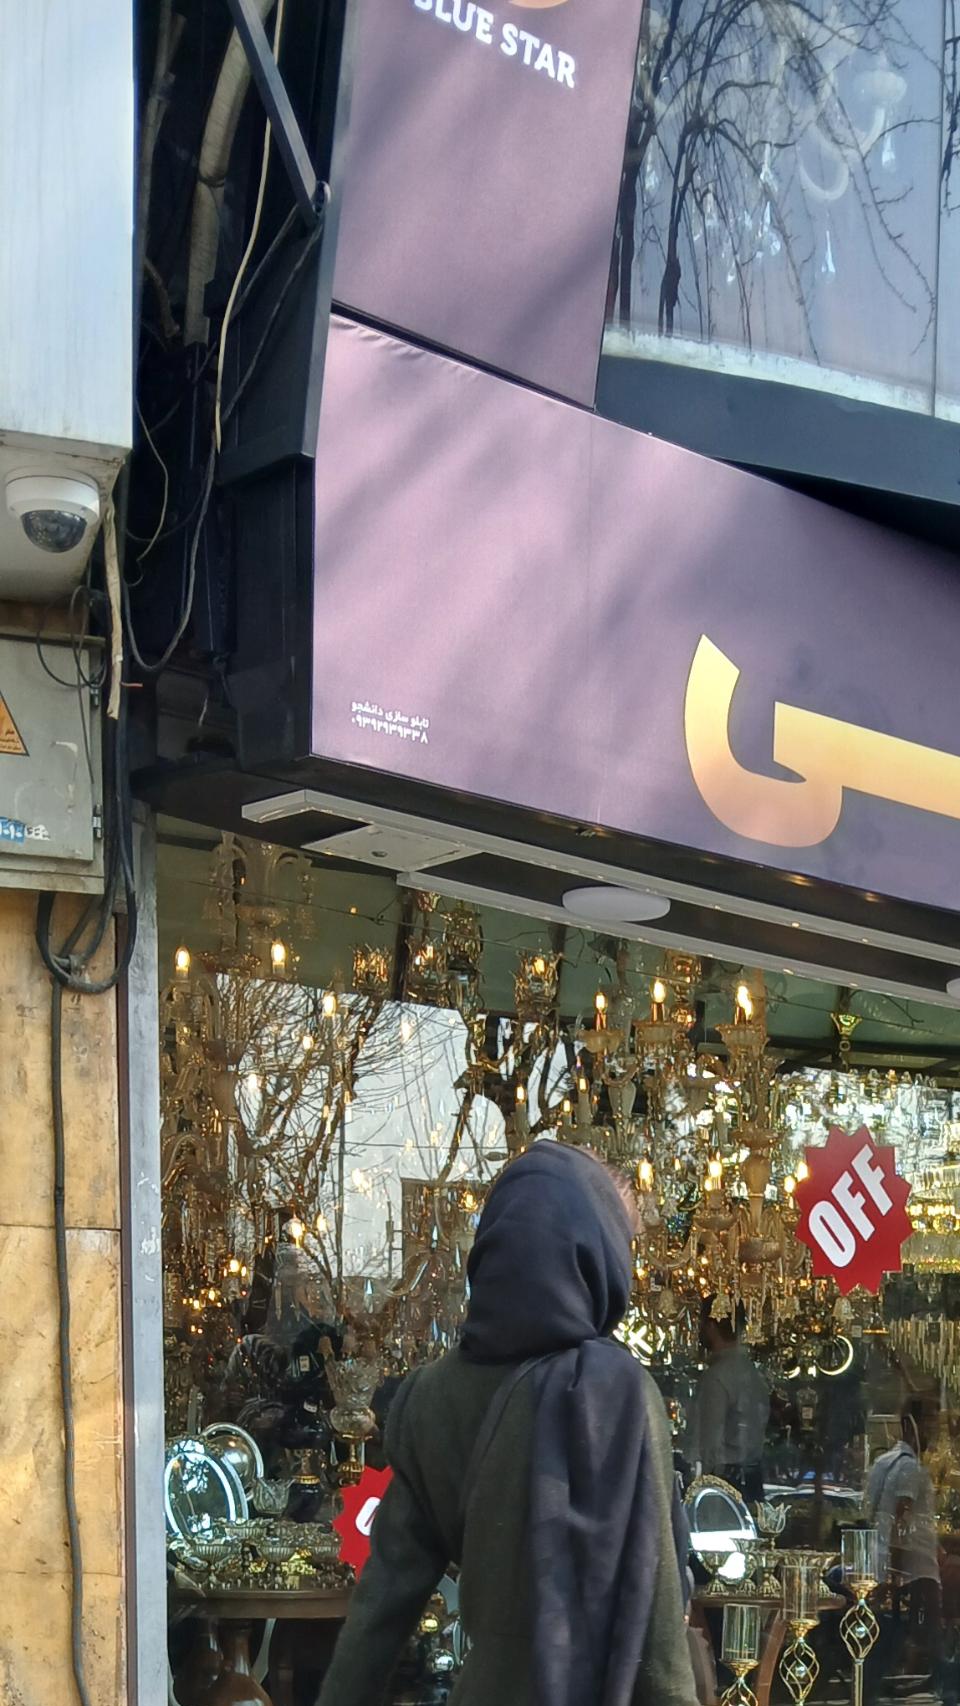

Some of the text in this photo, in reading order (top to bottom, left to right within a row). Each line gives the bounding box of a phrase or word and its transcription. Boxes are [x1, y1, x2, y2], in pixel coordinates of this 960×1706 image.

[500, 22, 575, 88] STAR
[351, 701, 430, 730] تابلو سازی دانشجو
[807, 1144, 893, 1269] OFF
